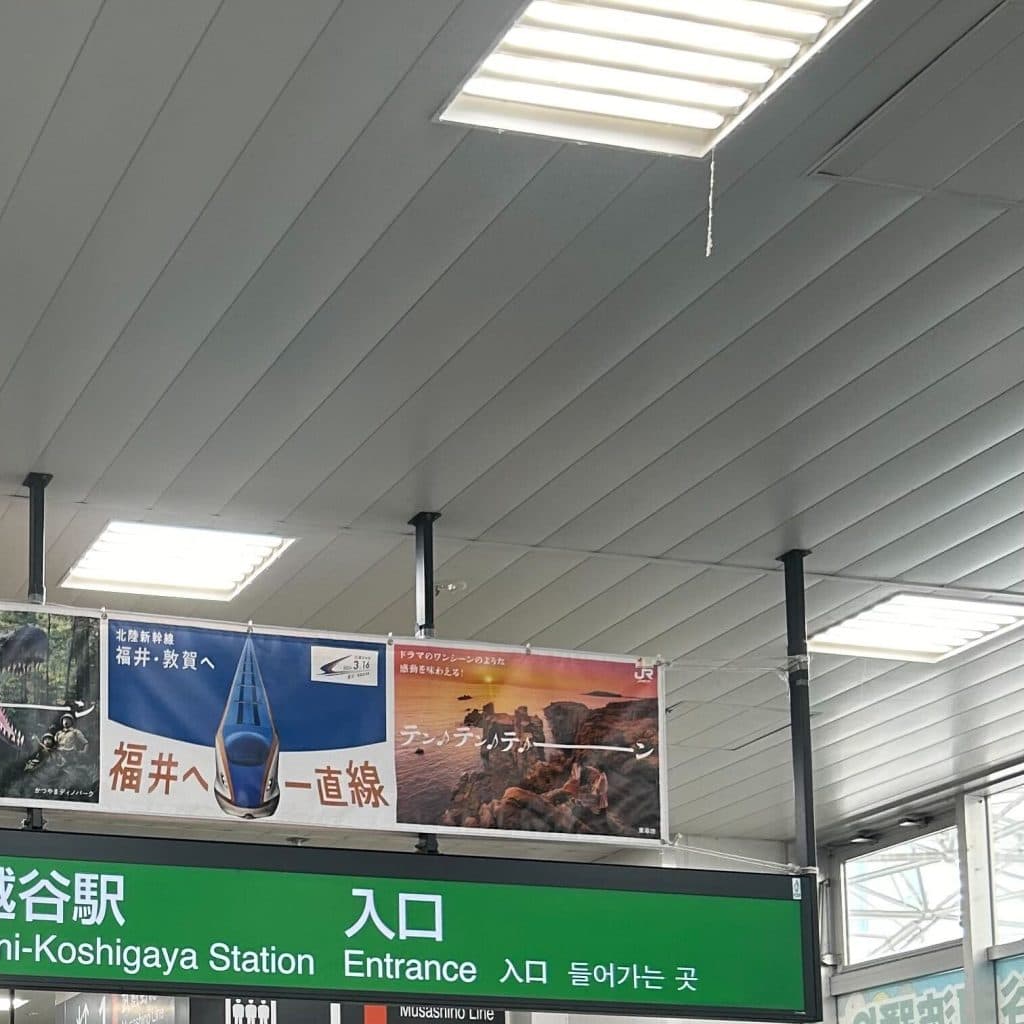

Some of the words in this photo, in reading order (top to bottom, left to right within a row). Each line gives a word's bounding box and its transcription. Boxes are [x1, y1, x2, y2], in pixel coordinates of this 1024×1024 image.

[115, 629, 175, 646] 北陸新幹線
[115, 646, 215, 671] 福井・敦賀へ
[634, 668, 653, 680] JR
[109, 741, 209, 796] 福井へ
[285, 759, 390, 809] 一直線
[344, 888, 445, 942] 入口
[208, 943, 316, 976] Station
[344, 950, 477, 984] Entrance
[499, 959, 548, 984] 入口
[567, 963, 666, 991] 들어가는
[676, 966, 699, 992] 곳
